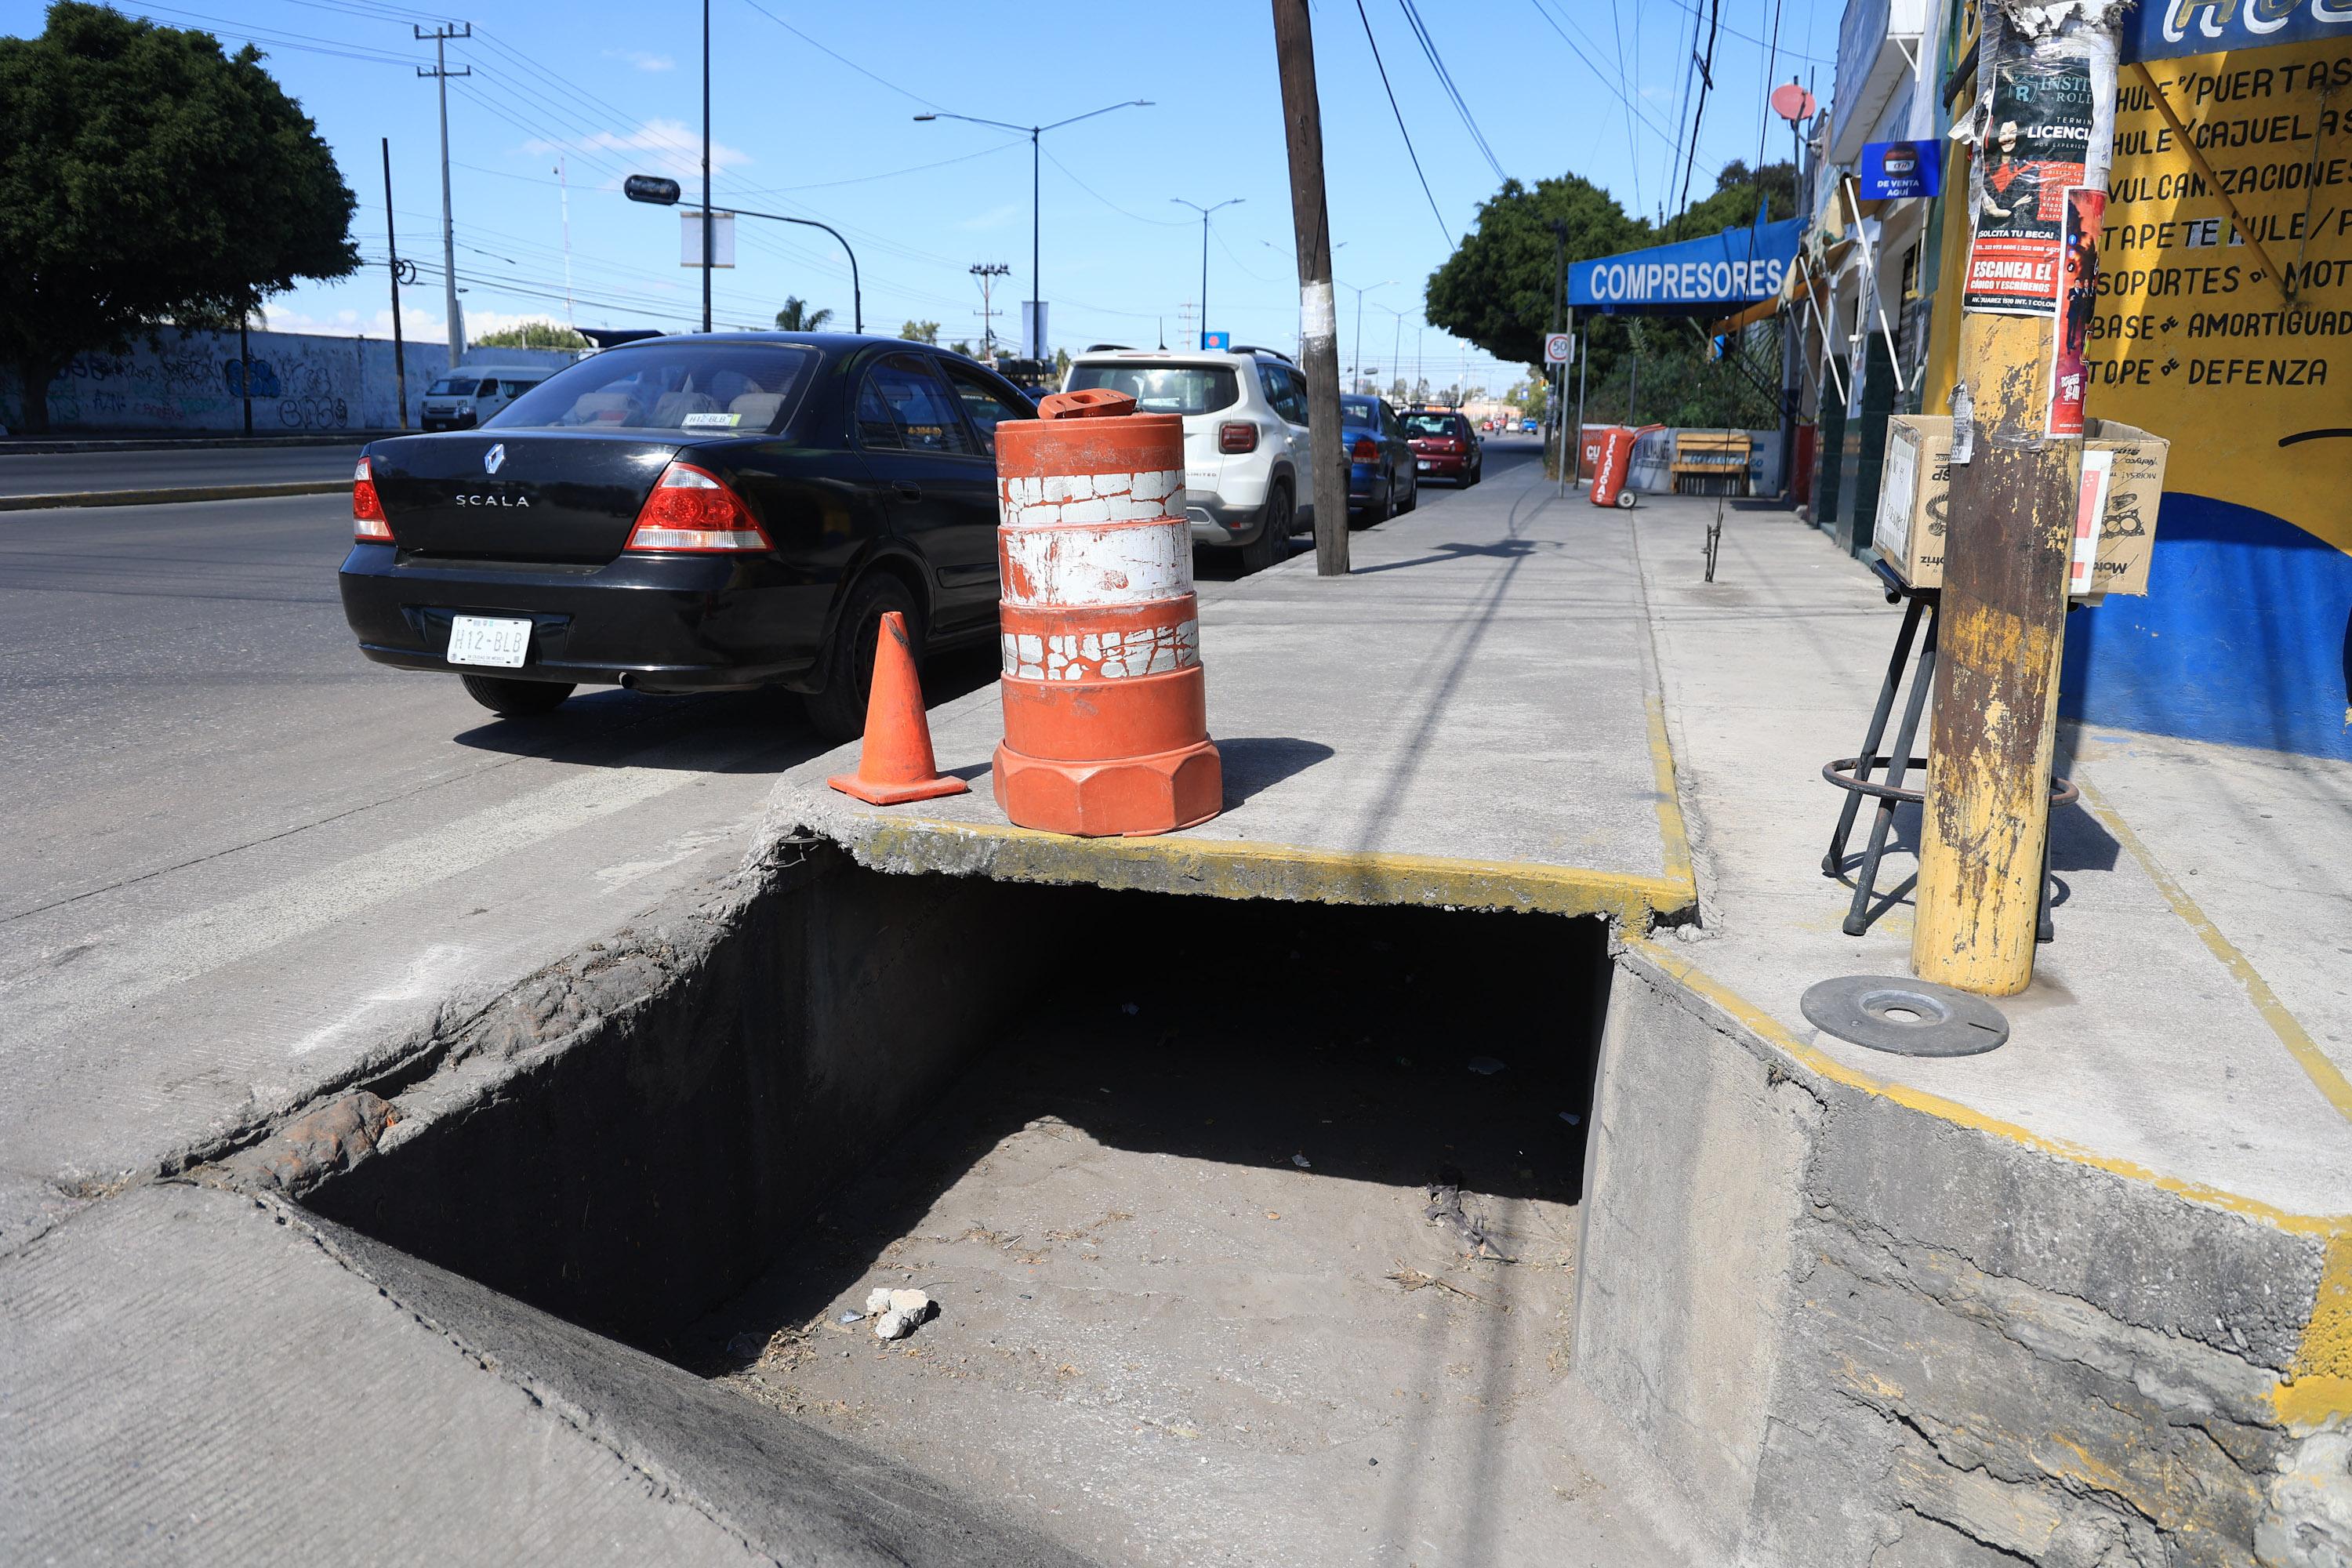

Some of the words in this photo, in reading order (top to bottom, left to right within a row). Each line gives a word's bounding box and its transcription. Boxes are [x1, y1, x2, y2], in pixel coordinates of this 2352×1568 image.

[2056, 116, 2092, 126] TERMIN
[2111, 128, 2172, 157] HULE
[2025, 230, 2054, 239] BECA!
[2102, 220, 2220, 251] TAPETE
[1591, 258, 1783, 301] COMPRESORES
[1973, 260, 2032, 280] ESCANEA
[2034, 263, 2052, 281] EL
[2096, 265, 2241, 297] SOPORTES
[1970, 279, 1994, 289] CÓDIGO
[1994, 281, 2000, 289] Y
[2001, 280, 2051, 293] ESCRÍBENOS
[2091, 314, 2155, 340] BASE
[2160, 315, 2179, 333] DE
[1553, 340, 1567, 351] 50
[2088, 359, 2154, 385] TOPE
[2161, 358, 2180, 377] DE
[2188, 358, 2328, 386] DEFENZA
[1596, 433, 1617, 503] RECARGAS
[455, 495, 529, 508] SCALA
[455, 629, 521, 653] H12-BLB
